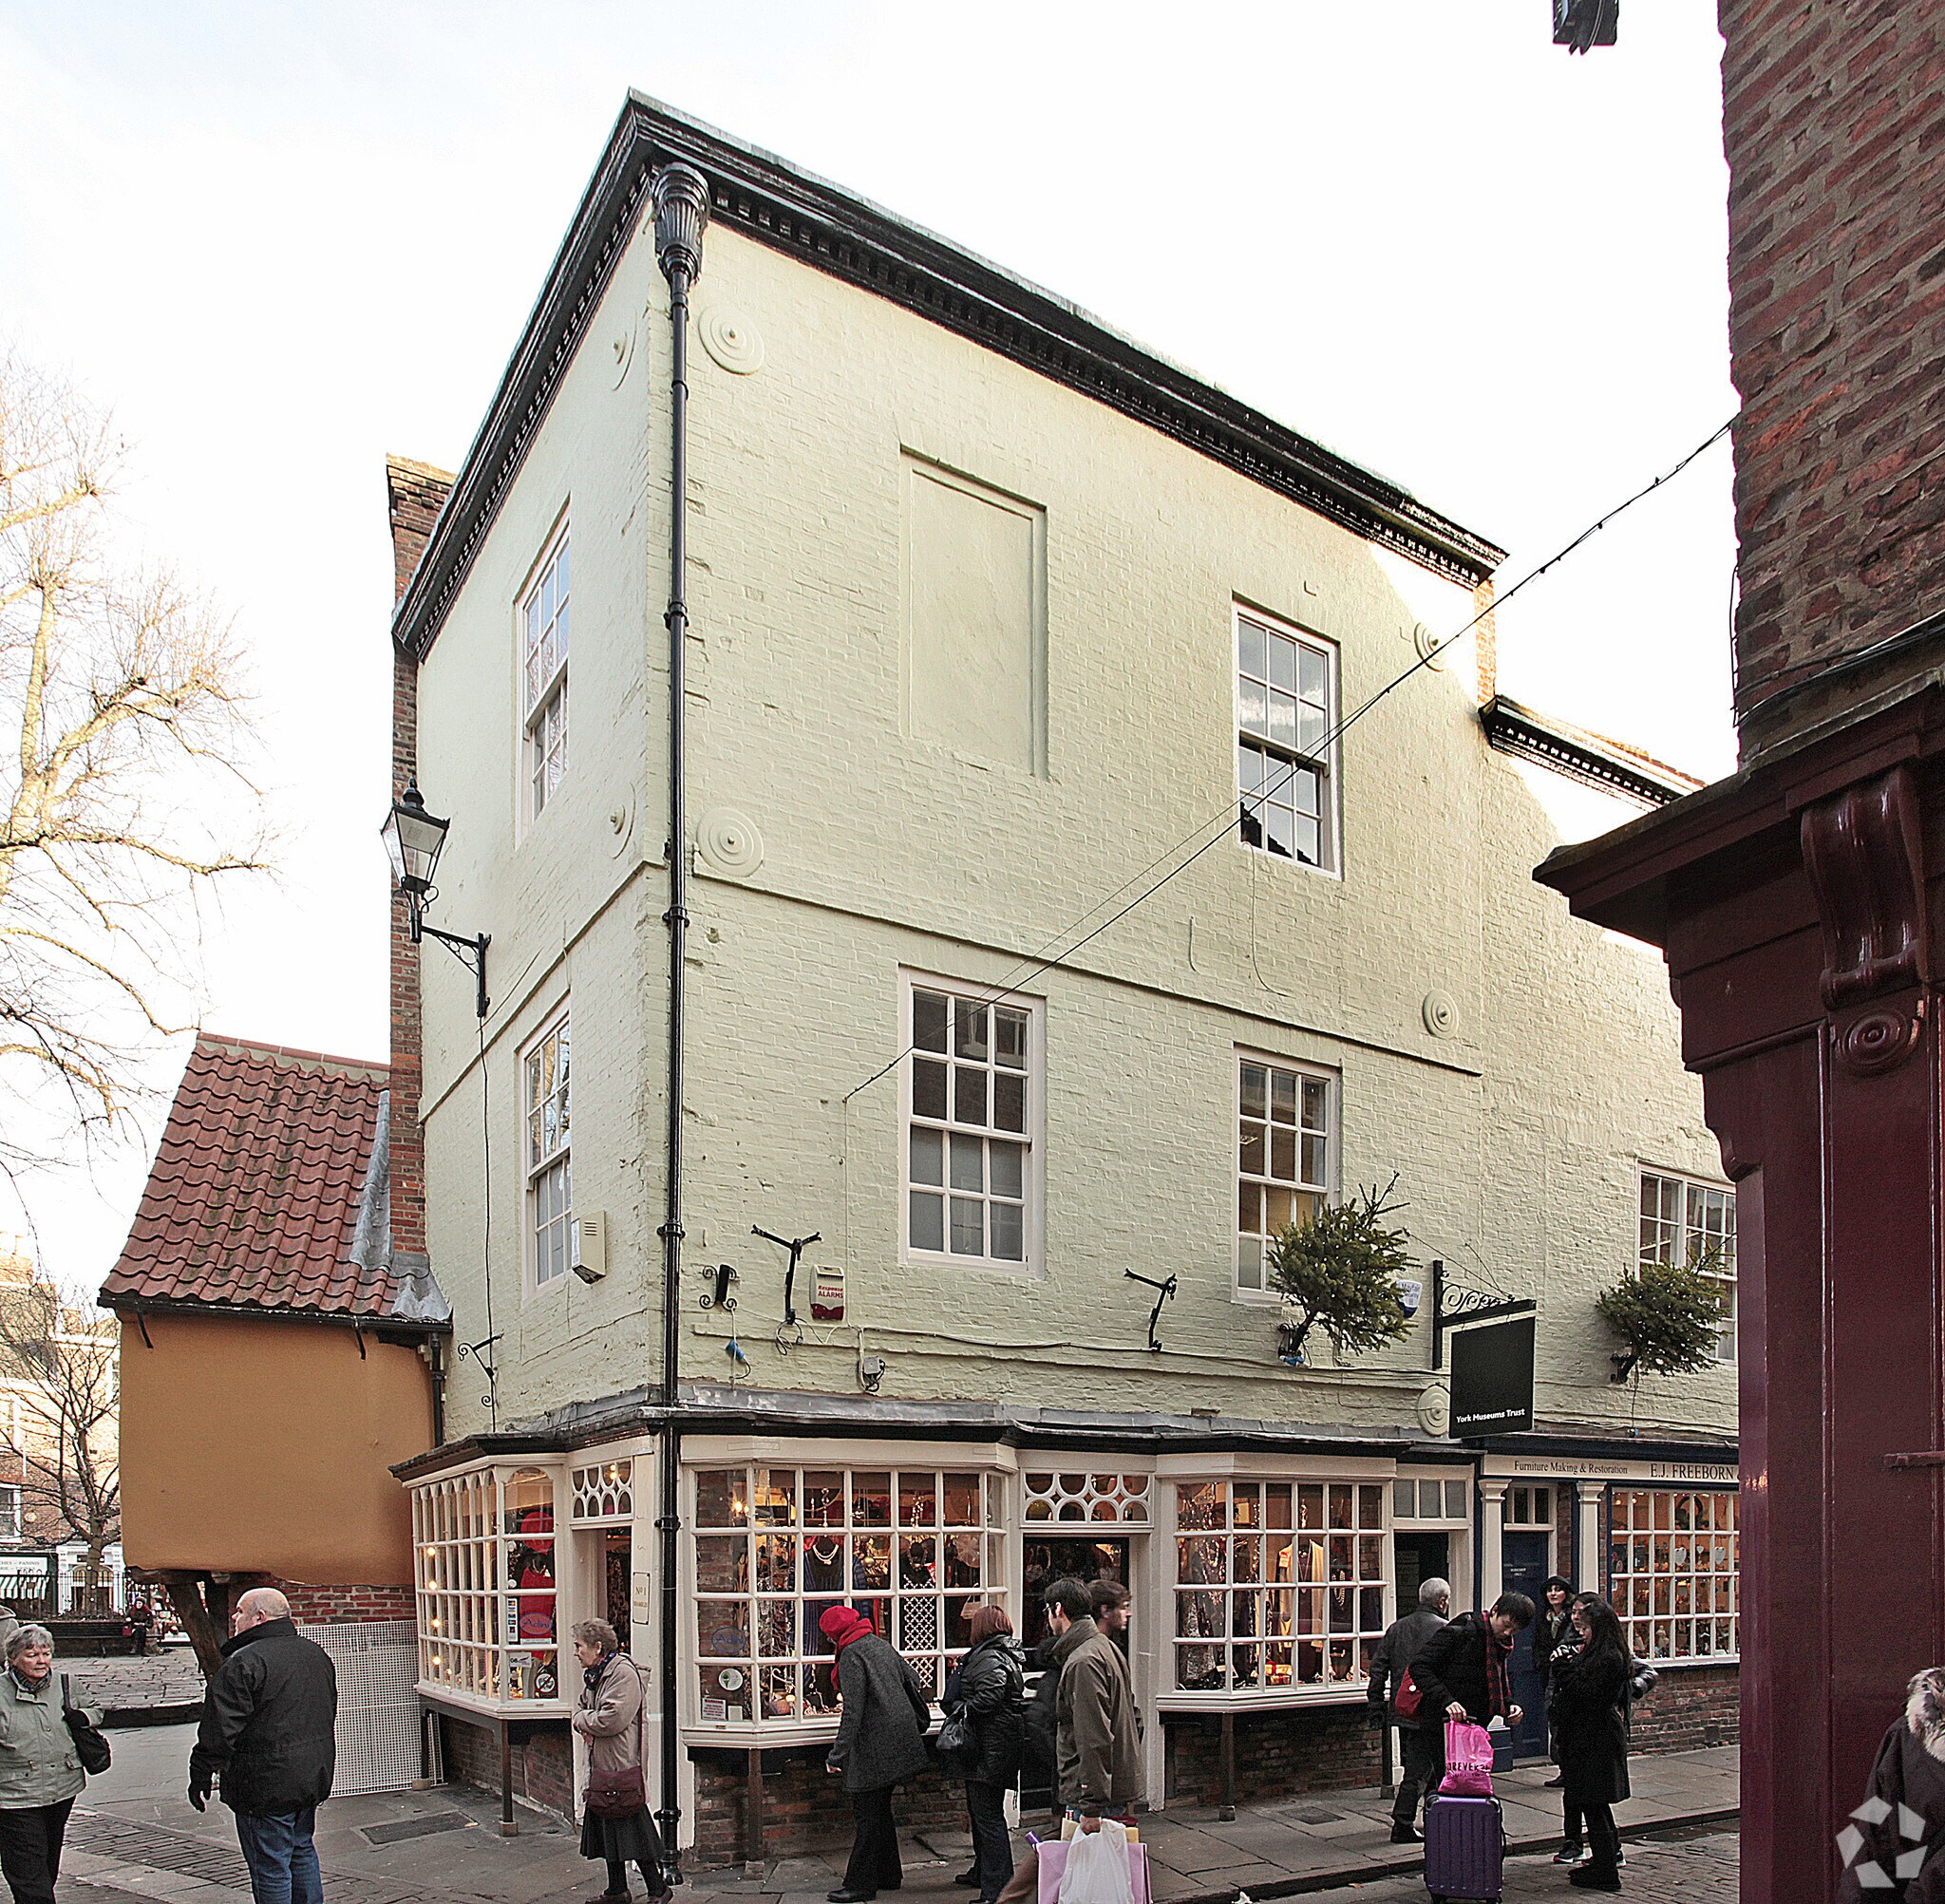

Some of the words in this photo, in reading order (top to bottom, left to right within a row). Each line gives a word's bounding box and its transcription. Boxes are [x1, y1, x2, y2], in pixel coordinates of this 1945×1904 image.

[1456, 1414, 1472, 1423] York
[1472, 1411, 1505, 1422] Museums
[1506, 1408, 1525, 1418] Trust
[1514, 1461, 1549, 1472] Furniture
[1550, 1461, 1577, 1475] Making
[1579, 1463, 1587, 1473] &
[1589, 1463, 1628, 1474] Restoration
[1651, 1463, 1669, 1478] E.J.
[1672, 1464, 1734, 1480] FREEBORN
